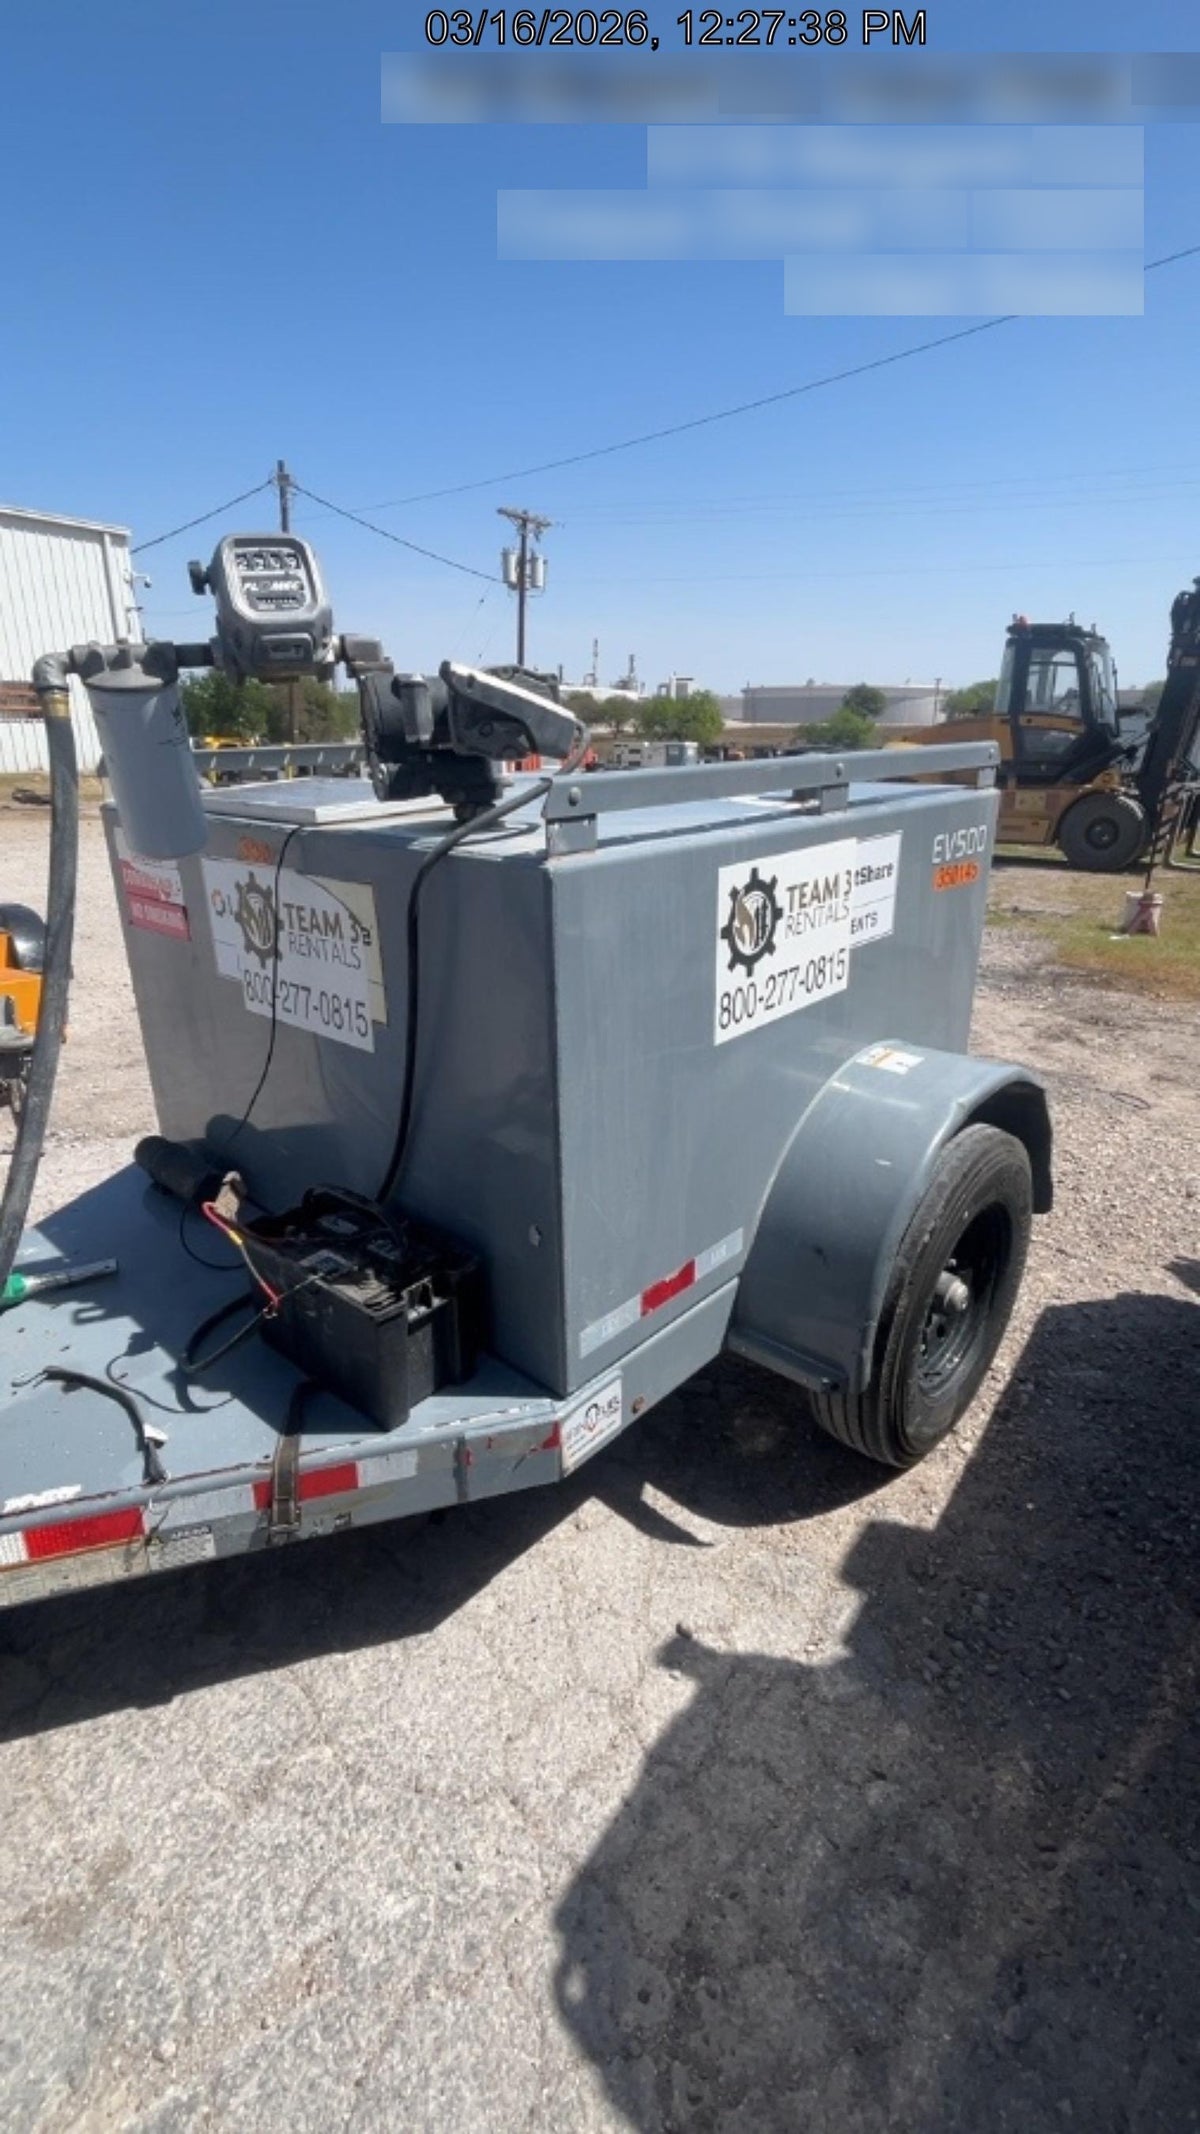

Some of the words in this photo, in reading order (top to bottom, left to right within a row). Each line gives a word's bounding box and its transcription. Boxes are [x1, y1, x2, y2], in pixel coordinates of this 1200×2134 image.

[931, 825, 987, 864] EV500
[785, 872, 840, 913] TEAM
[843, 869, 852, 897] 3
[282, 903, 344, 940] TEAM
[785, 904, 850, 939] RENTALS
[288, 932, 361, 970] RENTALS
[243, 969, 368, 1037] 800-277-0815
[719, 948, 845, 1029] 800-277-0815
